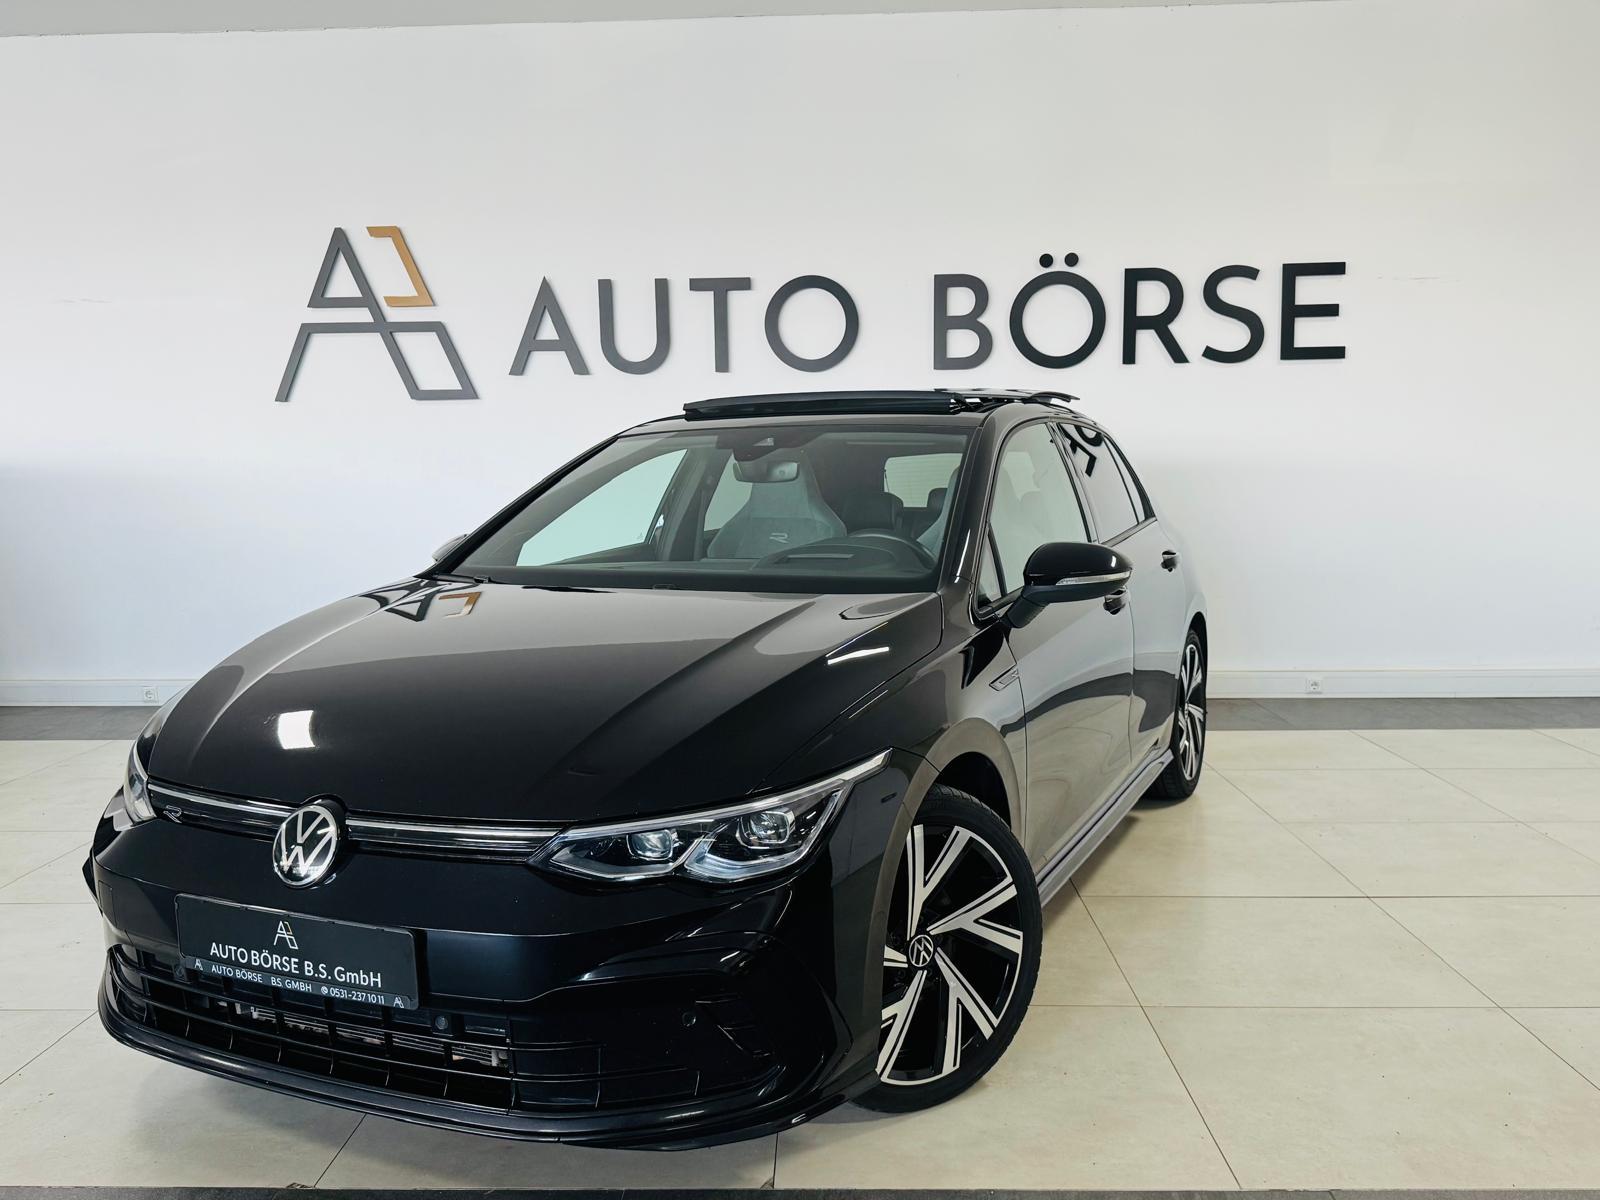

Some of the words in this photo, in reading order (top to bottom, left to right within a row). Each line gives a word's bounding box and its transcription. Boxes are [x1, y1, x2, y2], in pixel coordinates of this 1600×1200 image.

[508, 275, 860, 376] AUTO
[933, 252, 1347, 371] BÖRSE
[210, 941, 249, 964] AUTO
[250, 949, 300, 974] BÖRSE
[304, 960, 332, 980] B.S.
[334, 966, 382, 988] GmbH
[211, 964, 234, 977] AUTO
[235, 969, 263, 983] BÖRSE
[285, 979, 312, 992] GMBH
